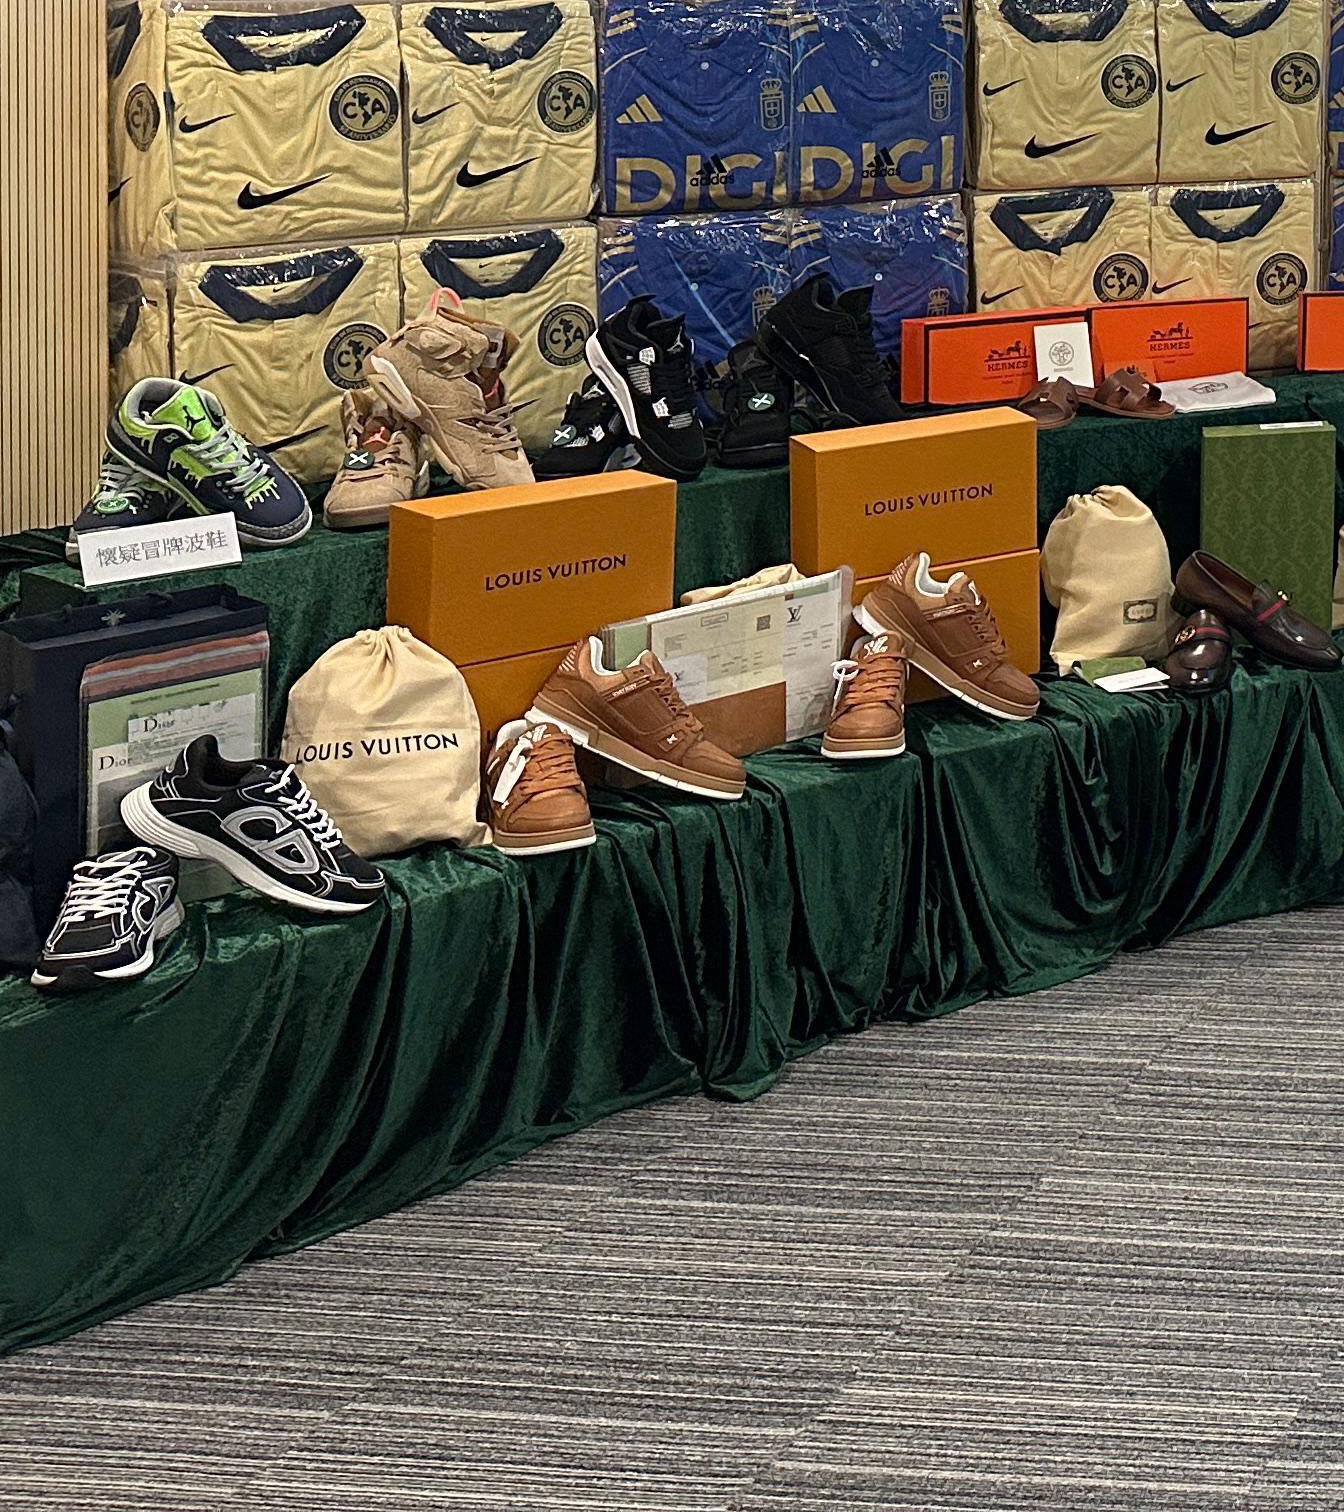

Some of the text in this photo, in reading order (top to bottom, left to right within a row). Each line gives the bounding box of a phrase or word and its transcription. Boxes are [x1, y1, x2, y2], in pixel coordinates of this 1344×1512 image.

[1111, 75, 1145, 89] C A
[1280, 70, 1313, 85] C A
[342, 97, 387, 119] C A
[549, 93, 585, 112] C A
[798, 134, 955, 201] DIGI
[861, 165, 902, 179] adidas
[614, 150, 789, 213] DIGI
[689, 172, 735, 188] adidas
[1104, 272, 1138, 289] C A
[1265, 273, 1297, 288] C A
[550, 327, 584, 345] C A
[1149, 341, 1191, 352] HERMES
[987, 360, 1029, 372] HERMES
[864, 483, 994, 517] LOUIS VUITTON
[95, 529, 228, 568] 懷疑冒牌波鞋
[485, 553, 627, 592] LOUIS VUITTON
[295, 740, 353, 765] LOUIS
[360, 733, 460, 757] VUITTON
